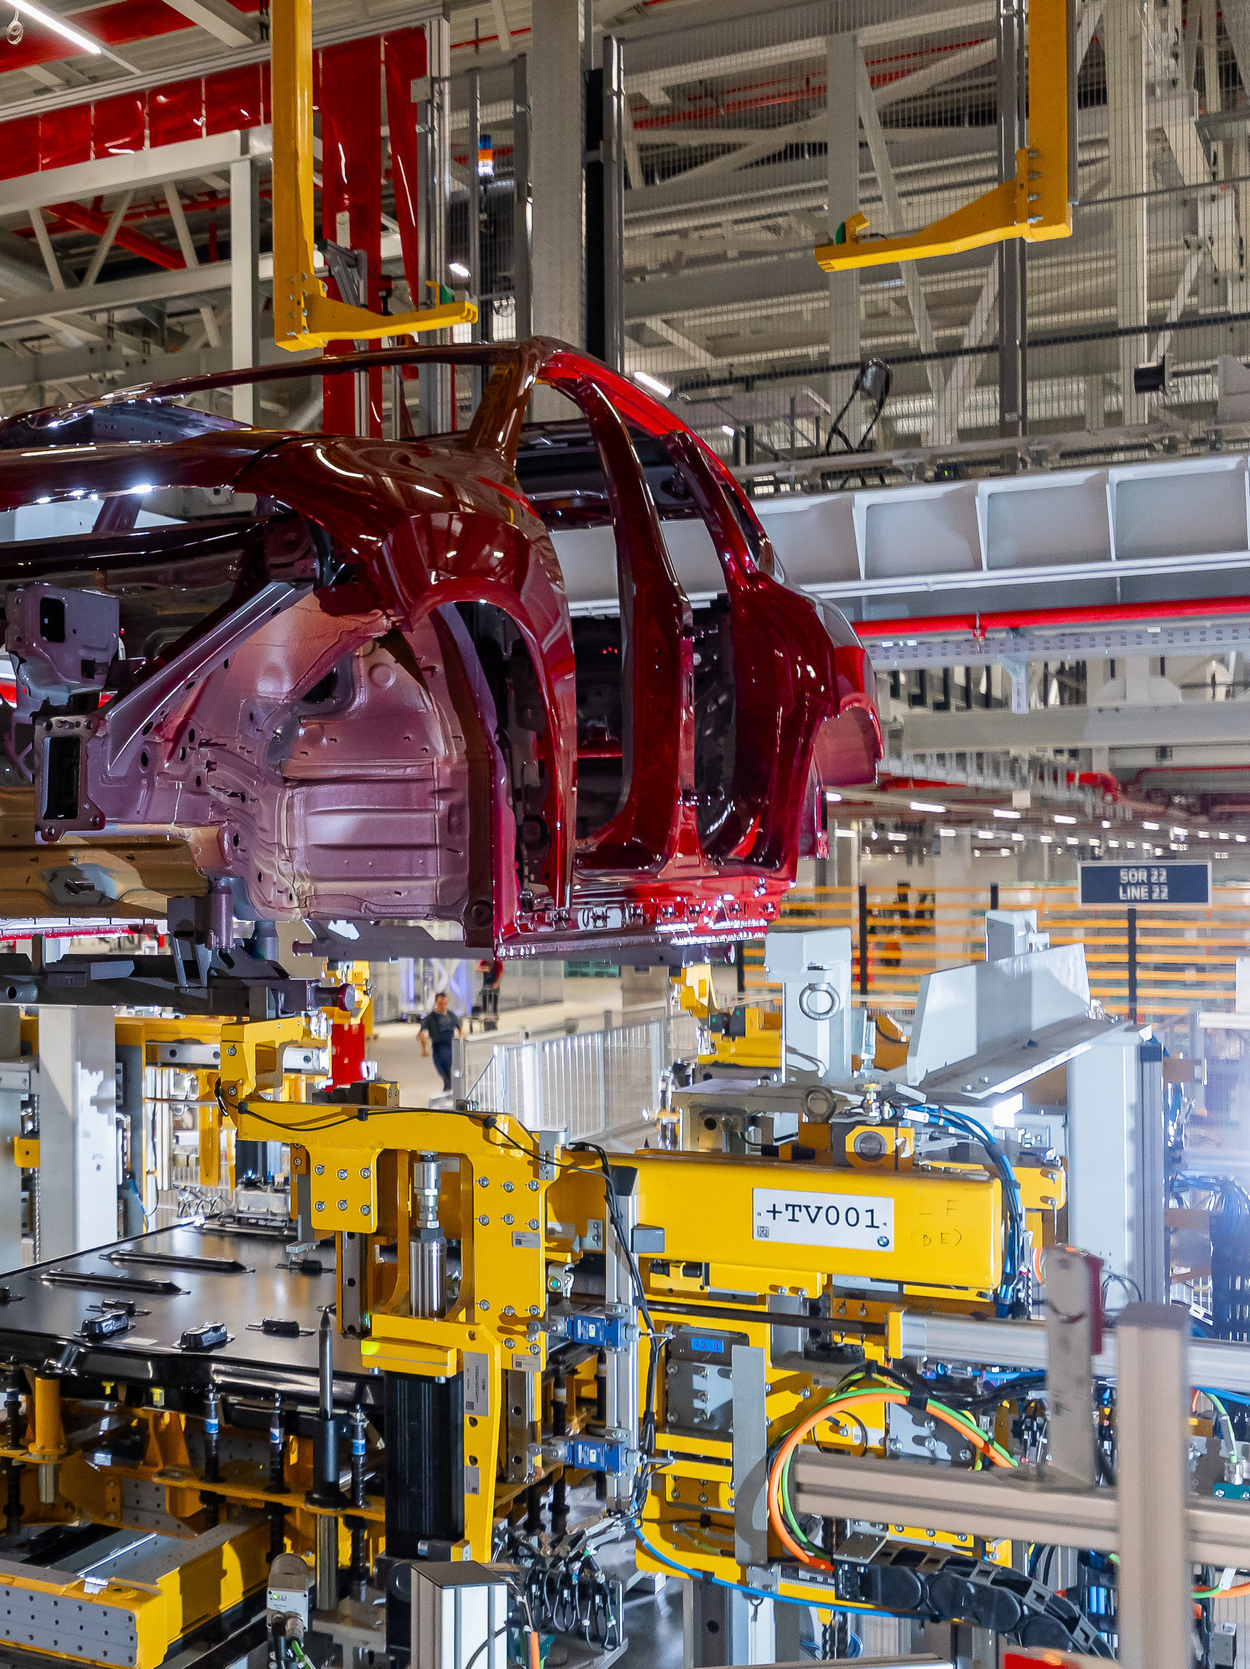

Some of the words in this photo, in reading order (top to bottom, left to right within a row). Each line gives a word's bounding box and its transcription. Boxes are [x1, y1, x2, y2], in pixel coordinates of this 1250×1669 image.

[1119, 868, 1147, 883] SOR
[1150, 868, 1167, 883] 22
[1119, 885, 1149, 900] LINE
[1152, 885, 1168, 900] 22
[766, 1203, 880, 1229] +TV001
